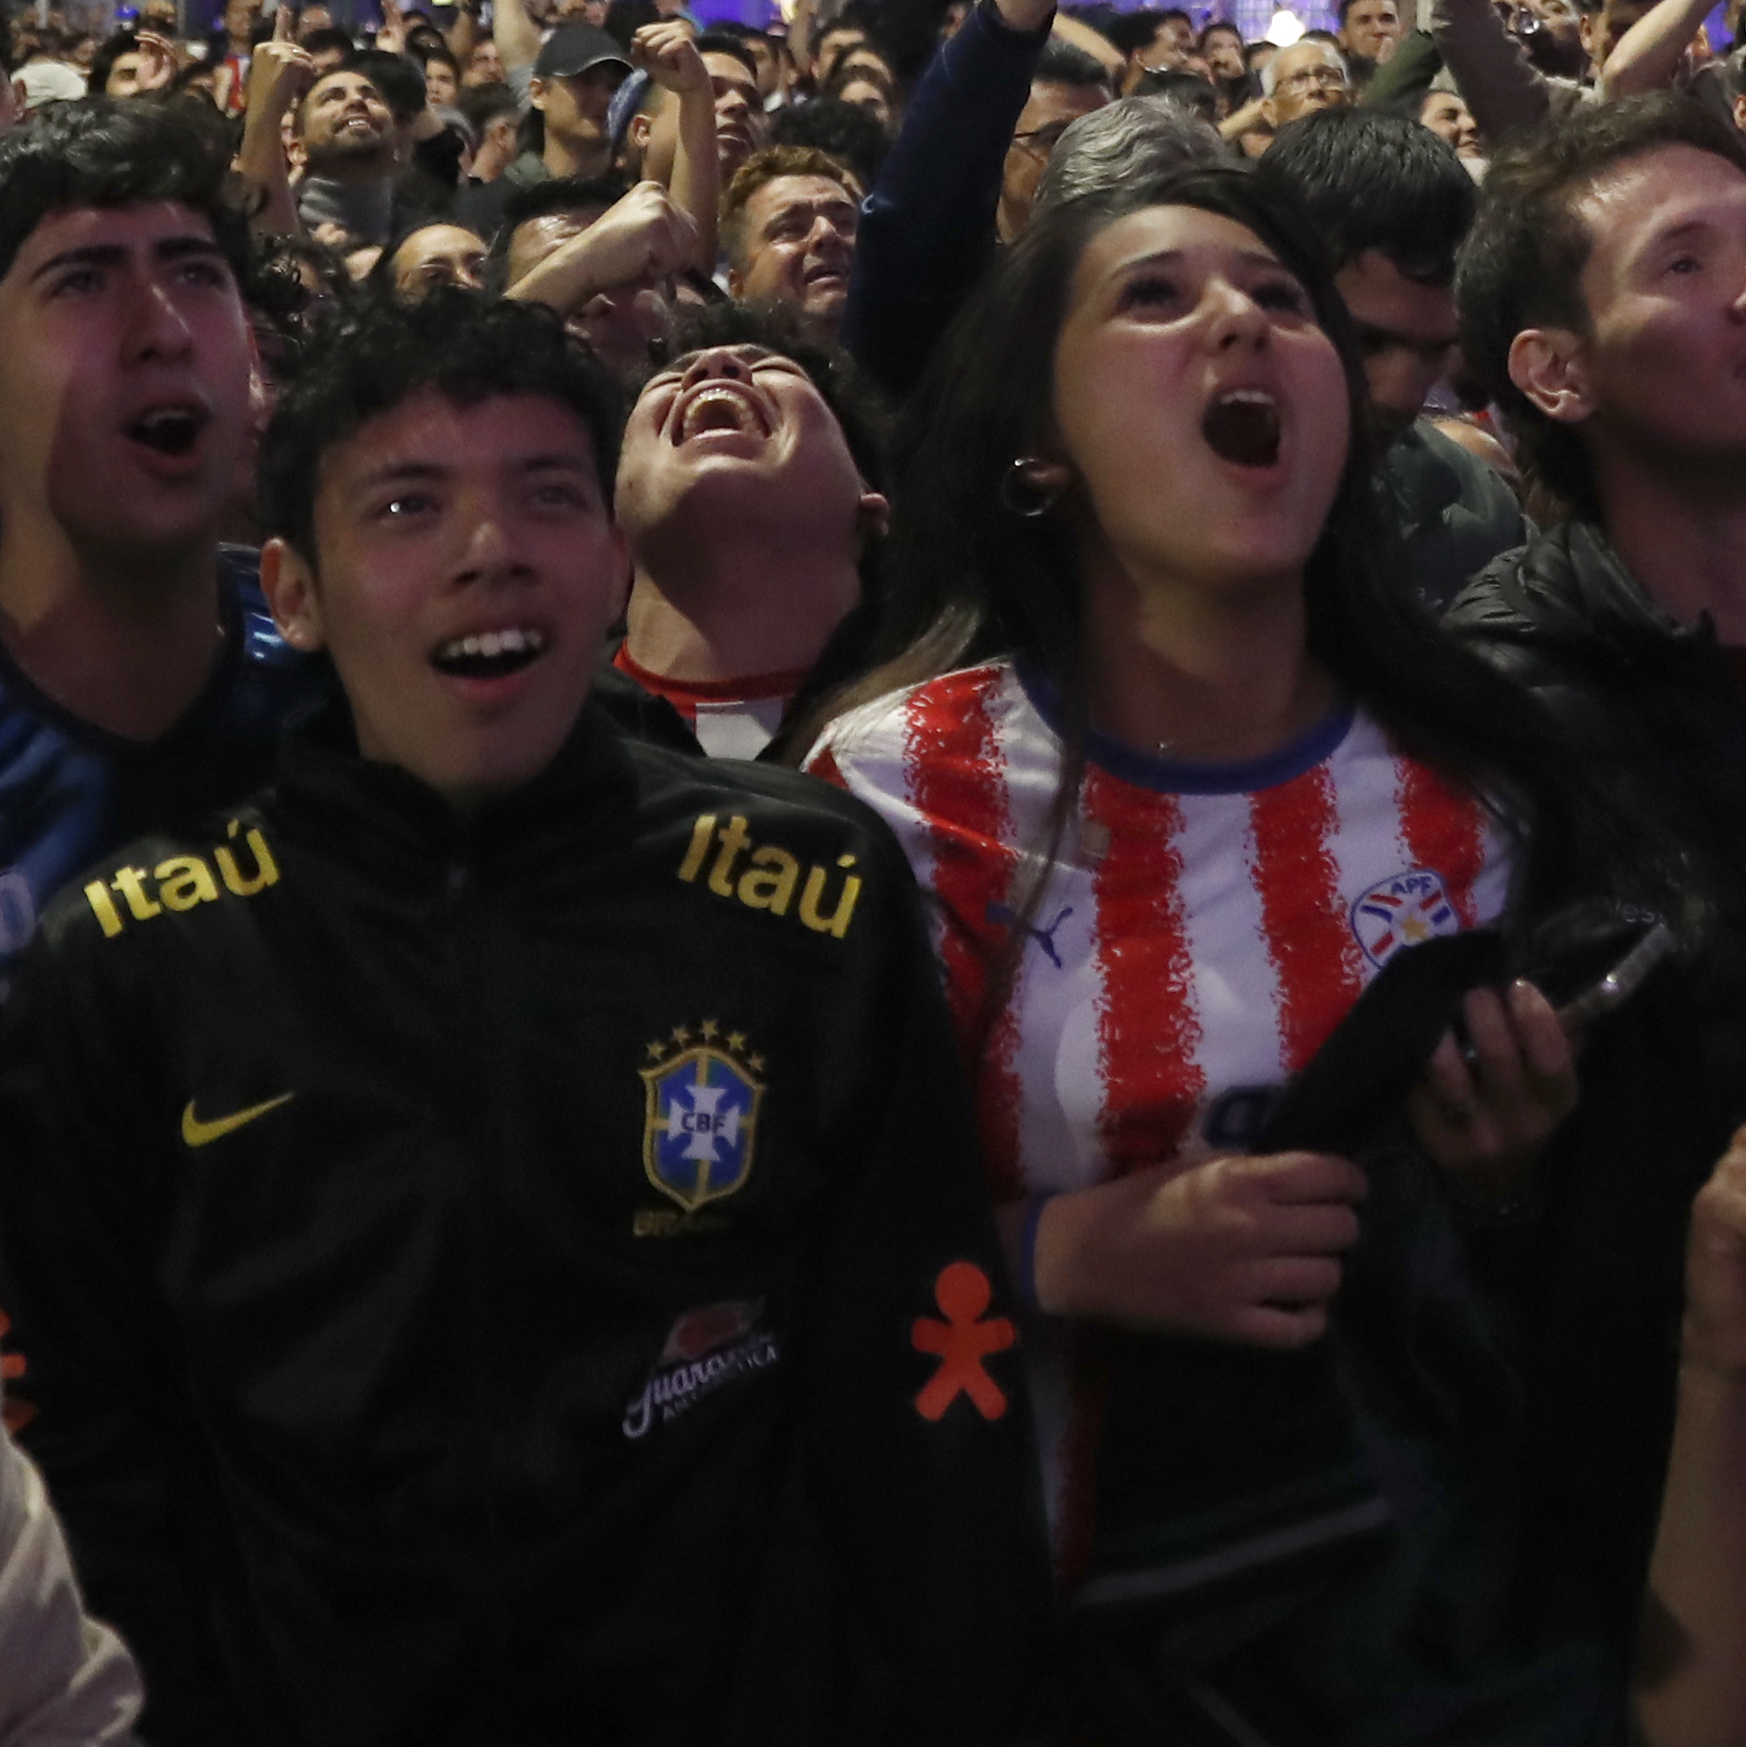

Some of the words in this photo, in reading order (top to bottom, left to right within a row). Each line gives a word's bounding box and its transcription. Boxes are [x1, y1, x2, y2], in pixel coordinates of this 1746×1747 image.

[83, 817, 280, 939] Itaú
[677, 813, 862, 939] Itaú
[1391, 875, 1432, 897] APF
[680, 1111, 728, 1136] CBF
[632, 1208, 727, 1238] BRA
